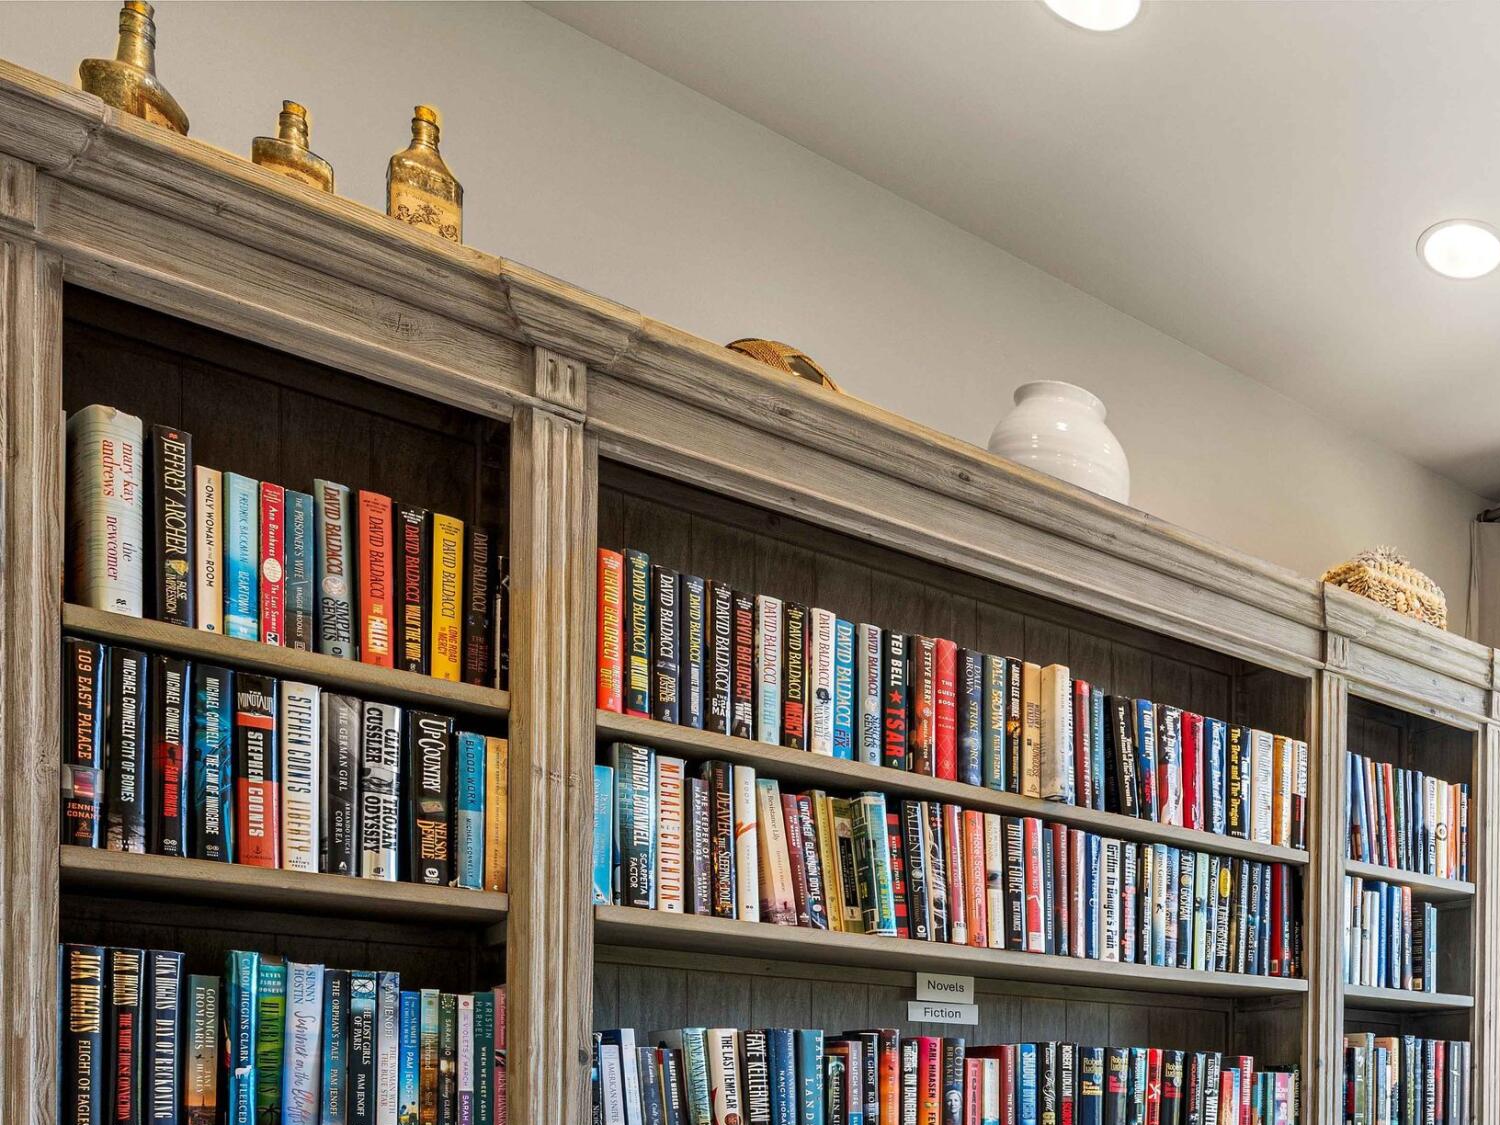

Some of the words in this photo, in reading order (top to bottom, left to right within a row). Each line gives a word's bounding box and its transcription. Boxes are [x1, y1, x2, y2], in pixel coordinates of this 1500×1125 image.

[102, 440, 117, 497] andrews
[120, 443, 135, 478] mary
[161, 437, 186, 497] JEFFREY
[123, 479, 138, 505] kay
[205, 485, 214, 510] ONLY
[239, 493, 248, 523] FREDRIK
[324, 486, 340, 520] DAVID
[165, 497, 187, 554] ARCHER
[206, 512, 214, 545] WOMAN
[295, 510, 304, 557] PRISONER'S
[369, 516, 384, 547] DAVID
[405, 525, 420, 556] DAVID
[106, 516, 118, 580] newcomer
[122, 542, 137, 562] the
[239, 526, 248, 563] BACKMAN
[326, 522, 343, 576] BALDACCI
[206, 560, 214, 587] ROOM
[294, 560, 303, 579] WIFE
[369, 550, 384, 600] BALDACCI
[406, 556, 420, 603] BALDACCI
[165, 573, 177, 614] IMPRESSION
[176, 580, 187, 600] FALSE
[238, 571, 250, 614] BEARTOWN
[322, 597, 336, 642] GENIUS
[335, 600, 350, 643] SIMPLE
[406, 604, 421, 628] WALK
[716, 600, 729, 634] DAVID
[368, 615, 388, 655] FALLEN
[406, 627, 420, 641] THE
[789, 620, 801, 649] DAVID
[837, 626, 852, 662] DAVID
[891, 634, 903, 655] TED
[78, 649, 92, 671] 109
[406, 642, 421, 662] WIRE
[716, 636, 729, 690] BALDACCI
[123, 658, 136, 695] MICHAEL
[789, 652, 801, 699] BALDACCI
[891, 659, 903, 686] BELL
[78, 676, 92, 709] EAST
[836, 665, 851, 727] BALDACCI
[122, 697, 136, 739] CONNELLY
[288, 695, 312, 746] STEPHEN
[785, 702, 803, 737] MERCY
[885, 706, 905, 758] TSAR
[78, 713, 92, 760] PALACE
[122, 741, 135, 759] CITY
[366, 707, 382, 764] CUSSLER
[384, 728, 399, 768] CLIVE
[835, 729, 846, 747] FIX
[1231, 728, 1240, 743] The
[122, 761, 134, 773] OF
[248, 731, 263, 782] STEPHEN
[633, 747, 648, 790] PATRICIA
[1231, 745, 1240, 763] Bear
[288, 749, 311, 793] COONTS
[1231, 765, 1240, 781] and
[122, 774, 134, 802] BONES
[660, 763, 680, 823] MICHAEL
[1231, 782, 1240, 797] The
[248, 787, 263, 837] COONTS
[287, 799, 311, 853] LIBERTY
[364, 795, 379, 854] ODYSSEY
[382, 799, 397, 852] TROJAN
[633, 794, 649, 846] CORNWELL
[800, 801, 812, 836] UNTAMED
[1230, 798, 1240, 826] Dragon
[435, 822, 447, 860] NELSON
[906, 805, 923, 853] FALLEN
[1007, 824, 1022, 862] DRIVING
[630, 857, 638, 888] FACTOR
[640, 853, 648, 895] SCARPETTA
[660, 833, 680, 901] CRICHTON
[804, 842, 817, 875] GLENNON
[808, 878, 820, 901] DOYLE
[1009, 865, 1022, 894] FORCE
[70, 951, 101, 981] JACK
[113, 952, 139, 971] JACK
[155, 955, 177, 976] JACK
[113, 975, 138, 1006] HIGGINS
[155, 977, 176, 1010] HIGGINS
[195, 987, 205, 1017] FROM
[294, 968, 304, 1004] HOSTIN
[306, 971, 315, 1003] SUNNY
[927, 980, 965, 993] Novels
[70, 984, 101, 1033] HIGGINS
[119, 1013, 133, 1027] THE
[205, 988, 215, 1048] GOODNIGHT
[924, 1007, 962, 1019] Fiction
[119, 1029, 132, 1051] WHITE
[155, 1019, 173, 1039] DAY
[194, 1020, 204, 1050] PARIS
[722, 1035, 733, 1049] THE
[747, 1033, 764, 1057] FAYE
[77, 1040, 90, 1076] FLIGHT
[118, 1053, 132, 1076] HOUSE
[155, 1041, 173, 1055] OF
[722, 1051, 733, 1072] LAST
[928, 1042, 937, 1062] CARL
[1062, 1045, 1071, 1069] ROBERT
[78, 1078, 90, 1091] OF
[155, 1057, 173, 1118] RECKONING
[724, 1077, 736, 1109] TEMPLAR
[748, 1061, 769, 1122] KELLERMAN
[928, 1064, 937, 1097] HIAASEN
[1062, 1071, 1071, 1096] LUDLUM
[117, 1077, 132, 1120] CONNECTION
